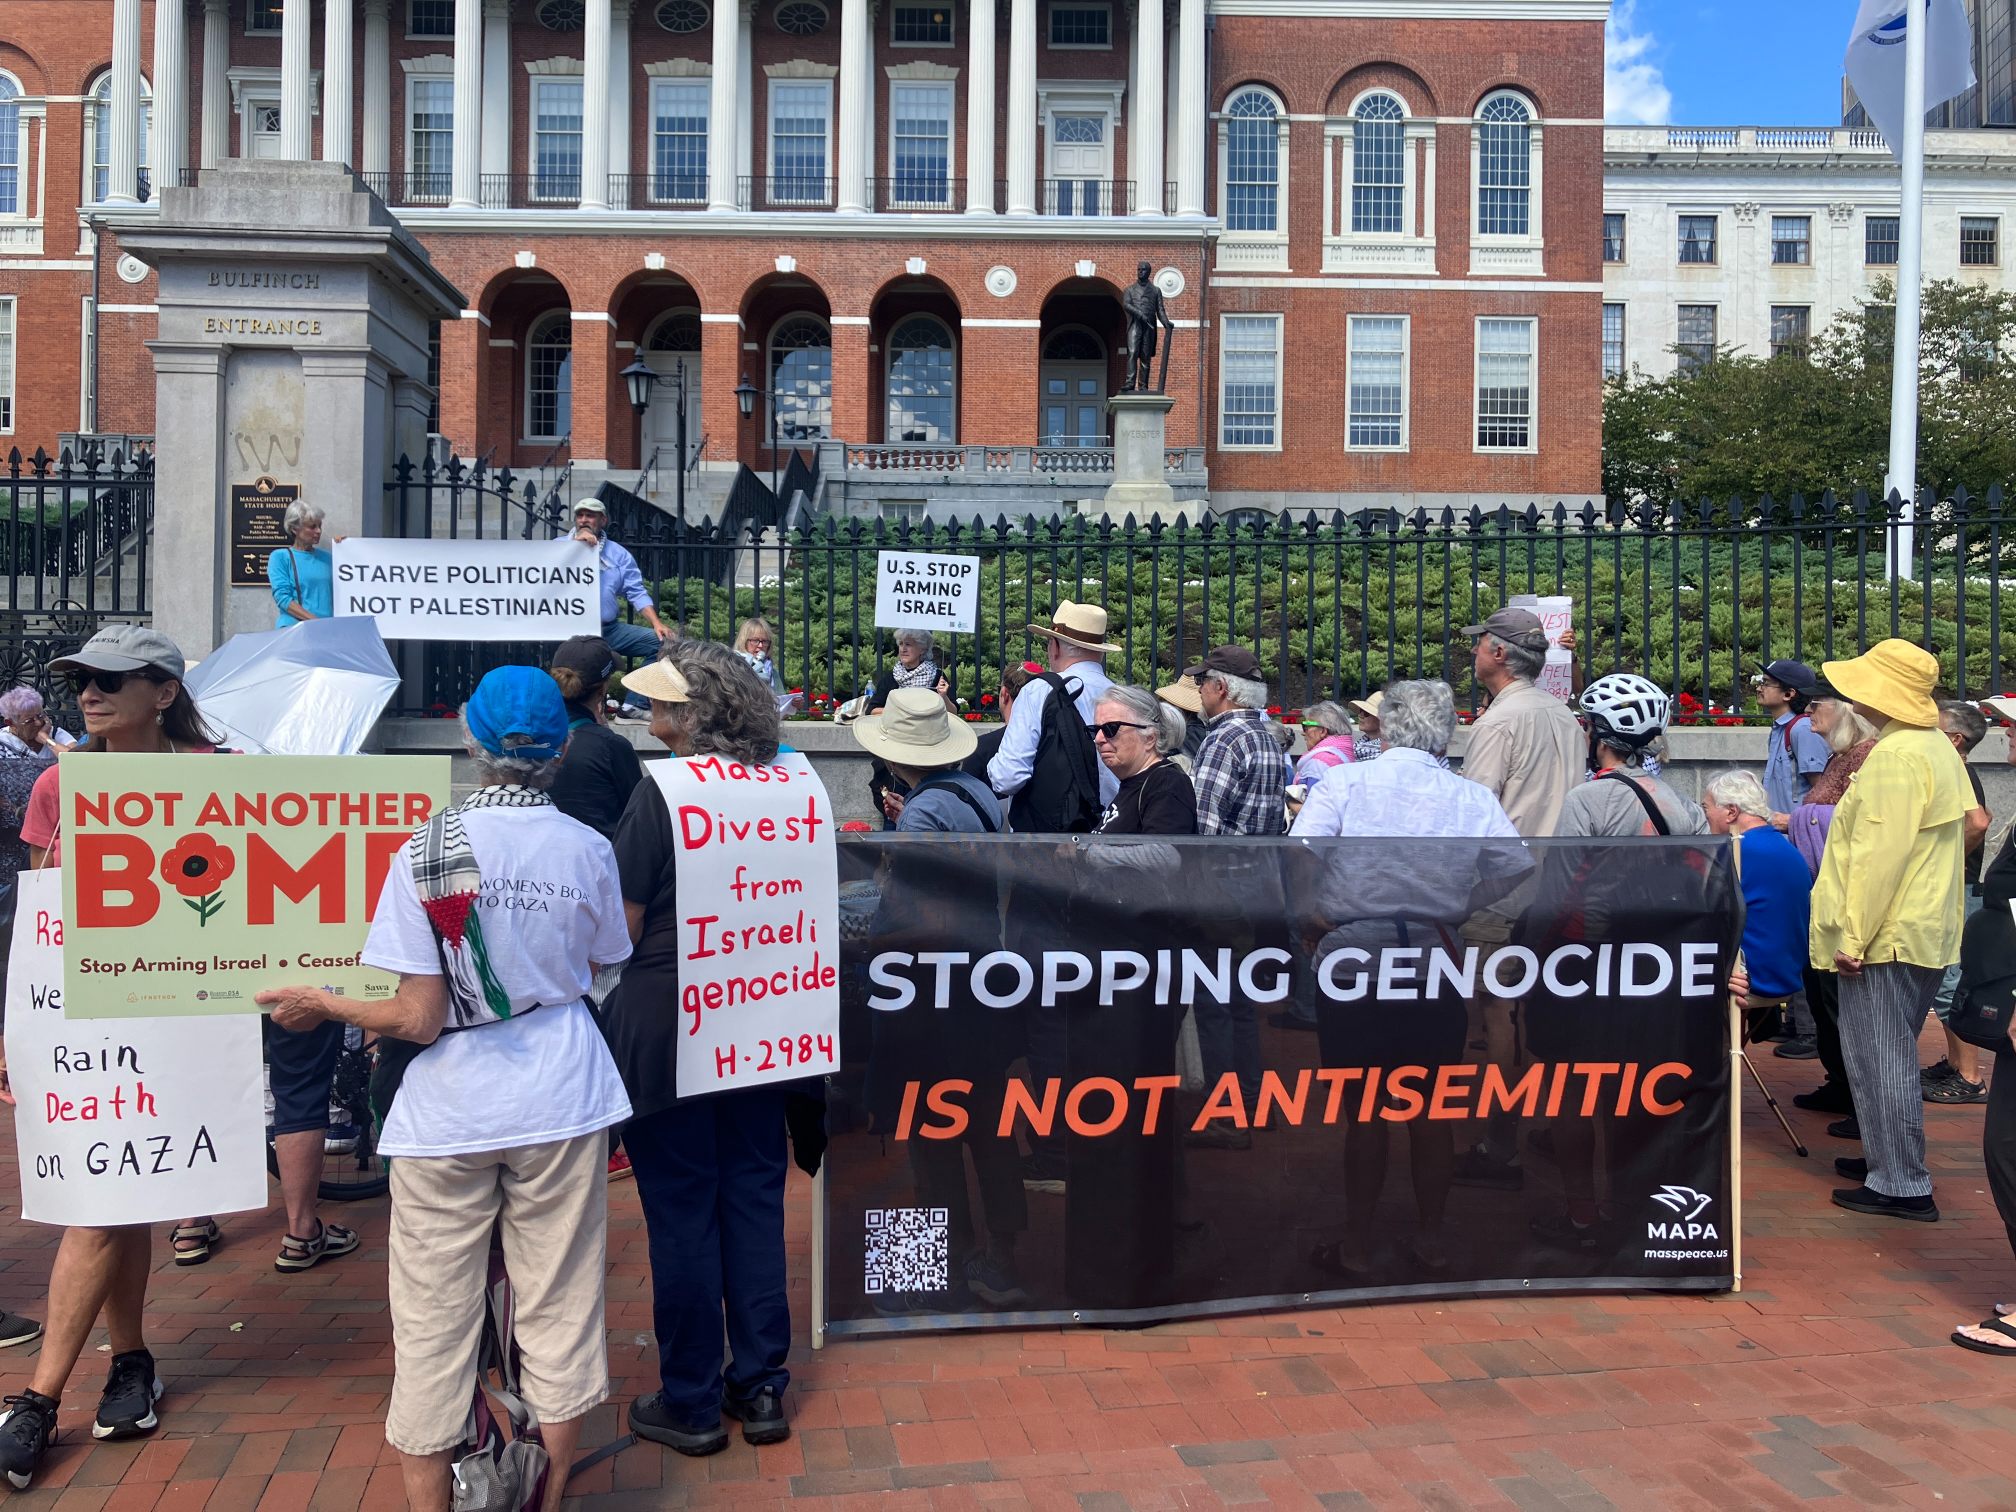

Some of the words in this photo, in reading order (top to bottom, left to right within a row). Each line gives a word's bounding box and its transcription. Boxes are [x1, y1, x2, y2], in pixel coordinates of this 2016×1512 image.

[207, 271, 320, 289] BULFINCH
[204, 317, 322, 335] ENTRANCE
[1121, 430, 1161, 439] WEBSTER
[338, 564, 438, 583] STARVE
[447, 566, 594, 586] POLITICIAN$
[887, 559, 920, 575] U.S.
[927, 562, 972, 578] STOP
[892, 579, 962, 597] ARMING
[350, 596, 401, 614] NOT
[410, 598, 585, 616] PALESTINIANS
[896, 599, 957, 616] ISRAEL
[1540, 664, 1571, 680] AEL
[1543, 687, 1568, 700] 984
[75, 791, 184, 827] NOT
[195, 792, 433, 827] ANOTHER
[678, 795, 823, 850] Divest
[479, 878, 555, 896] WOMEN'S
[560, 885, 592, 904] BOA
[730, 865, 803, 902] from
[478, 895, 500, 909] TO
[505, 896, 549, 913] GAZA
[686, 909, 818, 960] Israeli
[79, 957, 127, 977] Stop
[131, 956, 207, 976] Arming
[213, 953, 267, 970] Israel
[297, 951, 363, 967] Ceasef
[364, 983, 390, 991] Sawa
[867, 947, 1292, 1011] STOPPING
[1317, 942, 1719, 1002] GENOCIDE
[682, 951, 836, 1035] genocide
[54, 1038, 145, 1075] Rain
[46, 1081, 158, 1124] Death
[894, 1079, 973, 1141] IS
[997, 1075, 1182, 1137] NOT
[1191, 1062, 1694, 1132] ANTISEMITIC
[36, 1154, 65, 1181] on
[86, 1125, 218, 1176] GAZA
[1647, 1222, 1719, 1240] MAPA
[1644, 1249, 1728, 1261] masspeace.us
